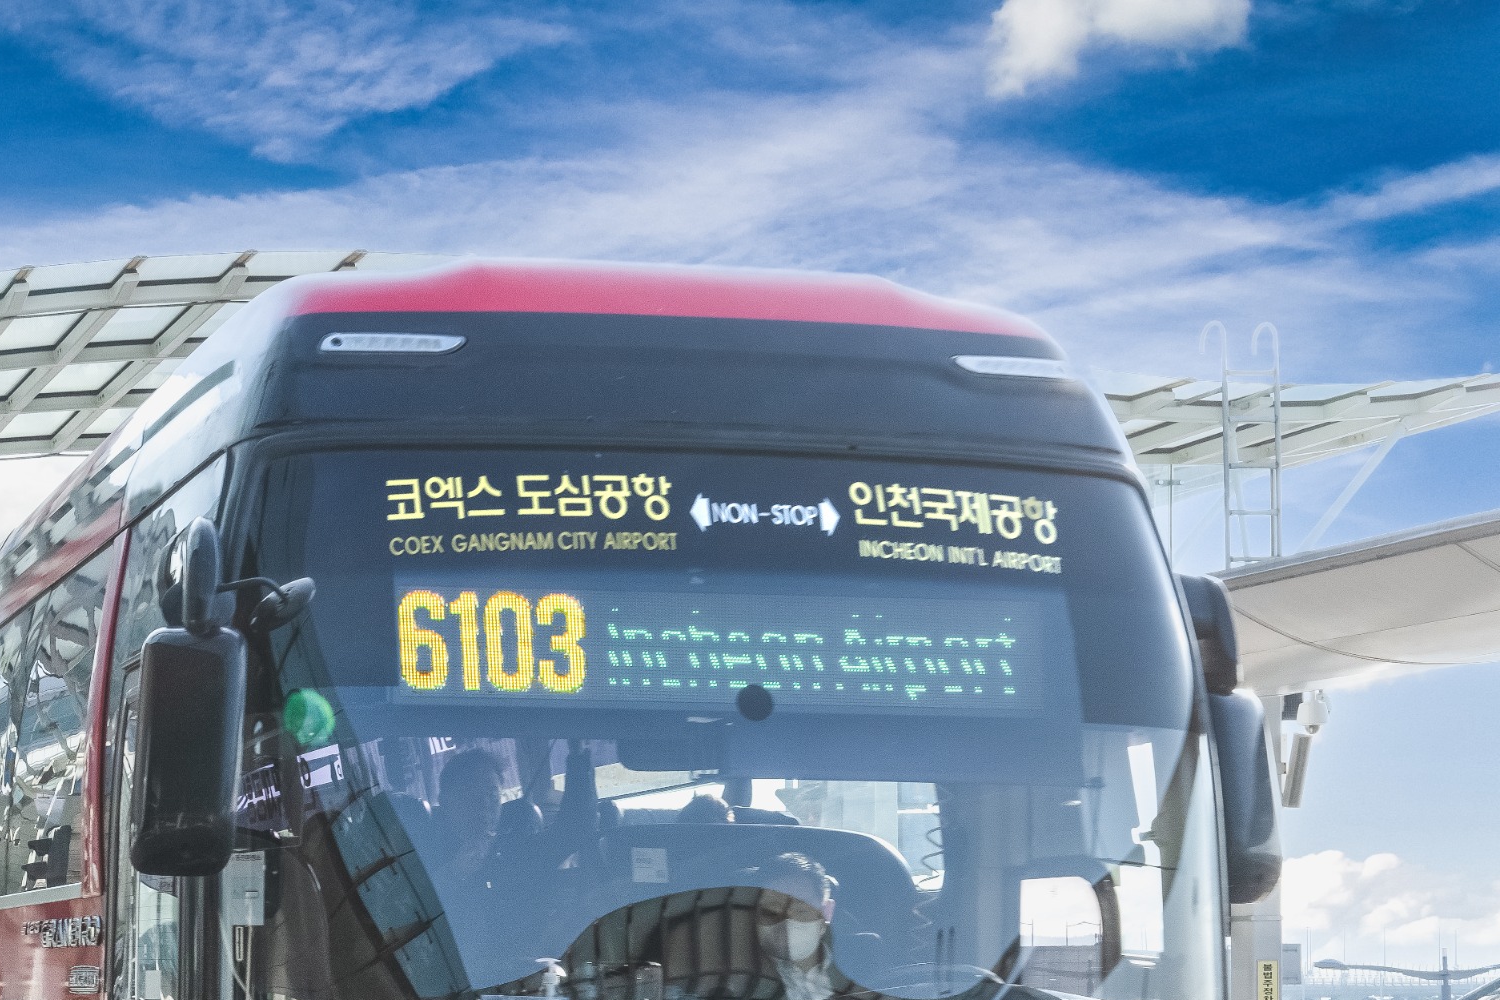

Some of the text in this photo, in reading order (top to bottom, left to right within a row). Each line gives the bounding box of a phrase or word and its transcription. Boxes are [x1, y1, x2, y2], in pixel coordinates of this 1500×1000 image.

[385, 473, 673, 521] 코엑스 도심공항
[711, 501, 819, 526] NON-STOP
[848, 481, 1059, 545] 인천국제공항
[388, 531, 678, 556] COEX GANGNAM CITY AIRPORT
[859, 539, 1063, 574] INCHEON INT'L AIRPORT
[398, 589, 587, 694] 6103
